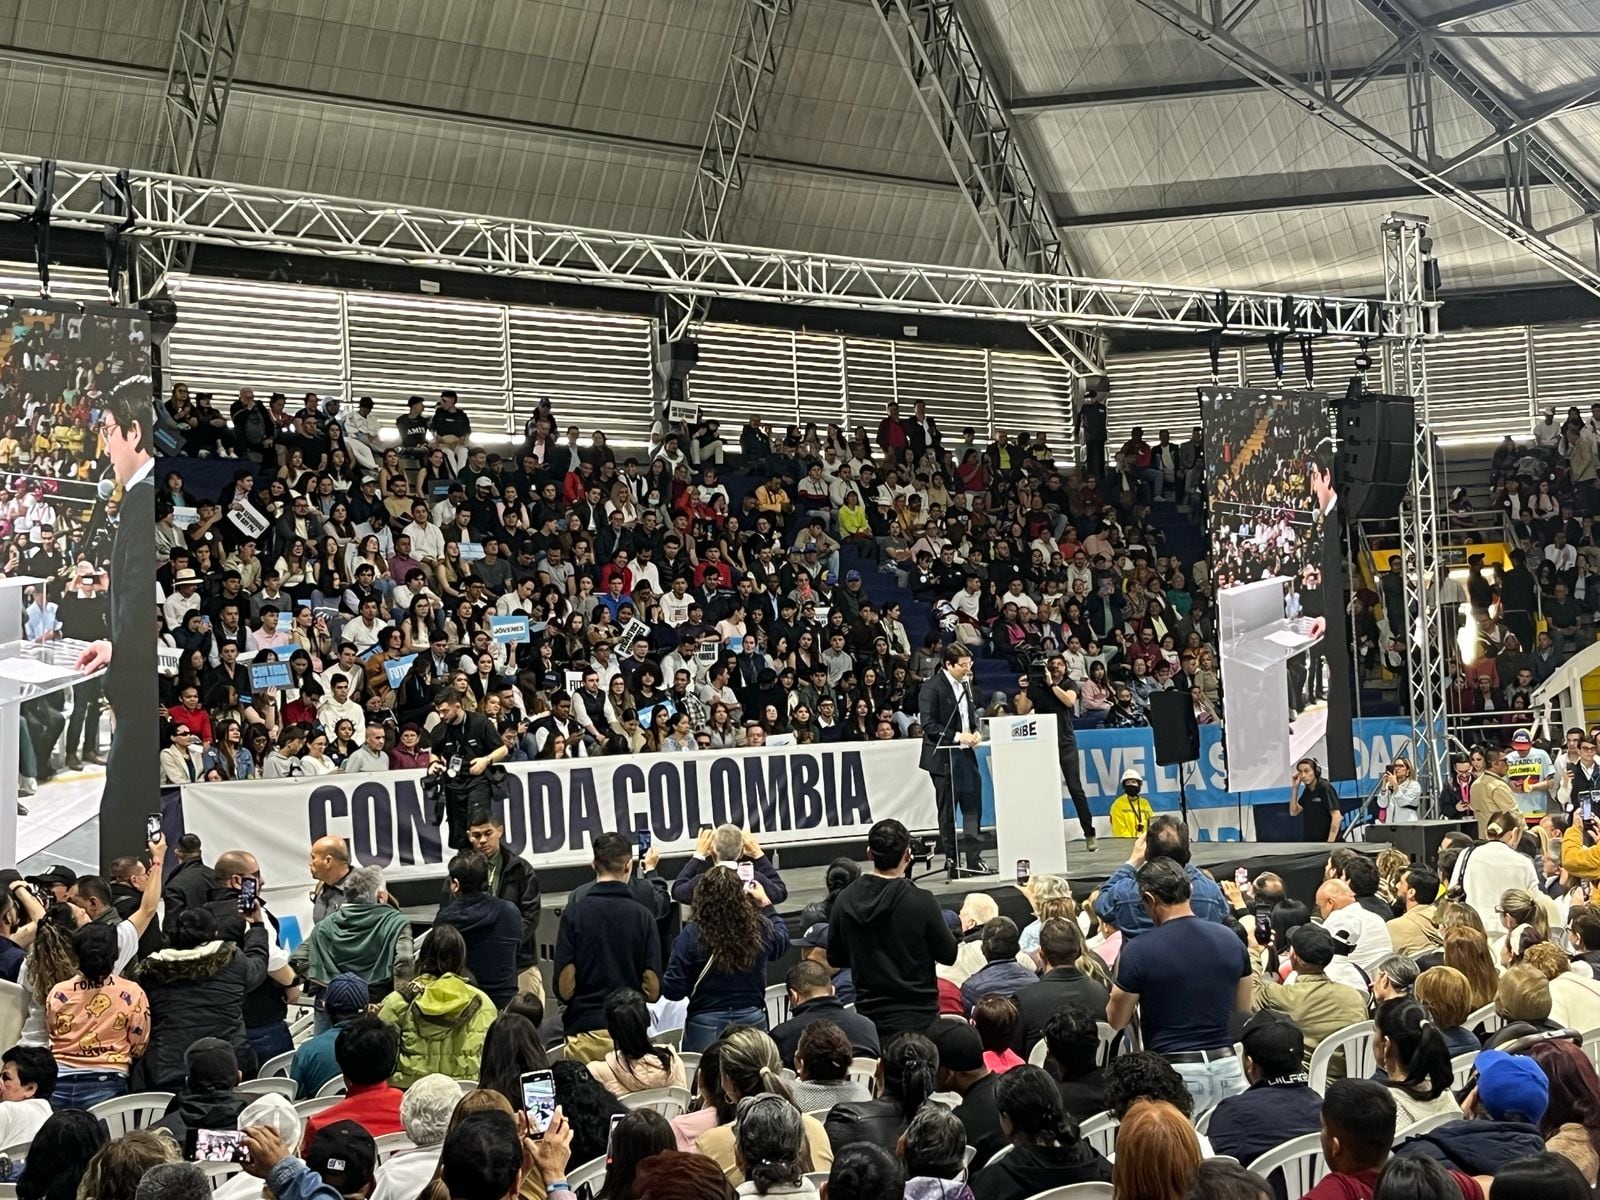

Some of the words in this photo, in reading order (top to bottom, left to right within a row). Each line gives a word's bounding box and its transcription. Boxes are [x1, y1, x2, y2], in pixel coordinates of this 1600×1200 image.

[308, 780, 443, 869] CON
[491, 766, 605, 856] ODA
[612, 750, 874, 846] COLOMBIA
